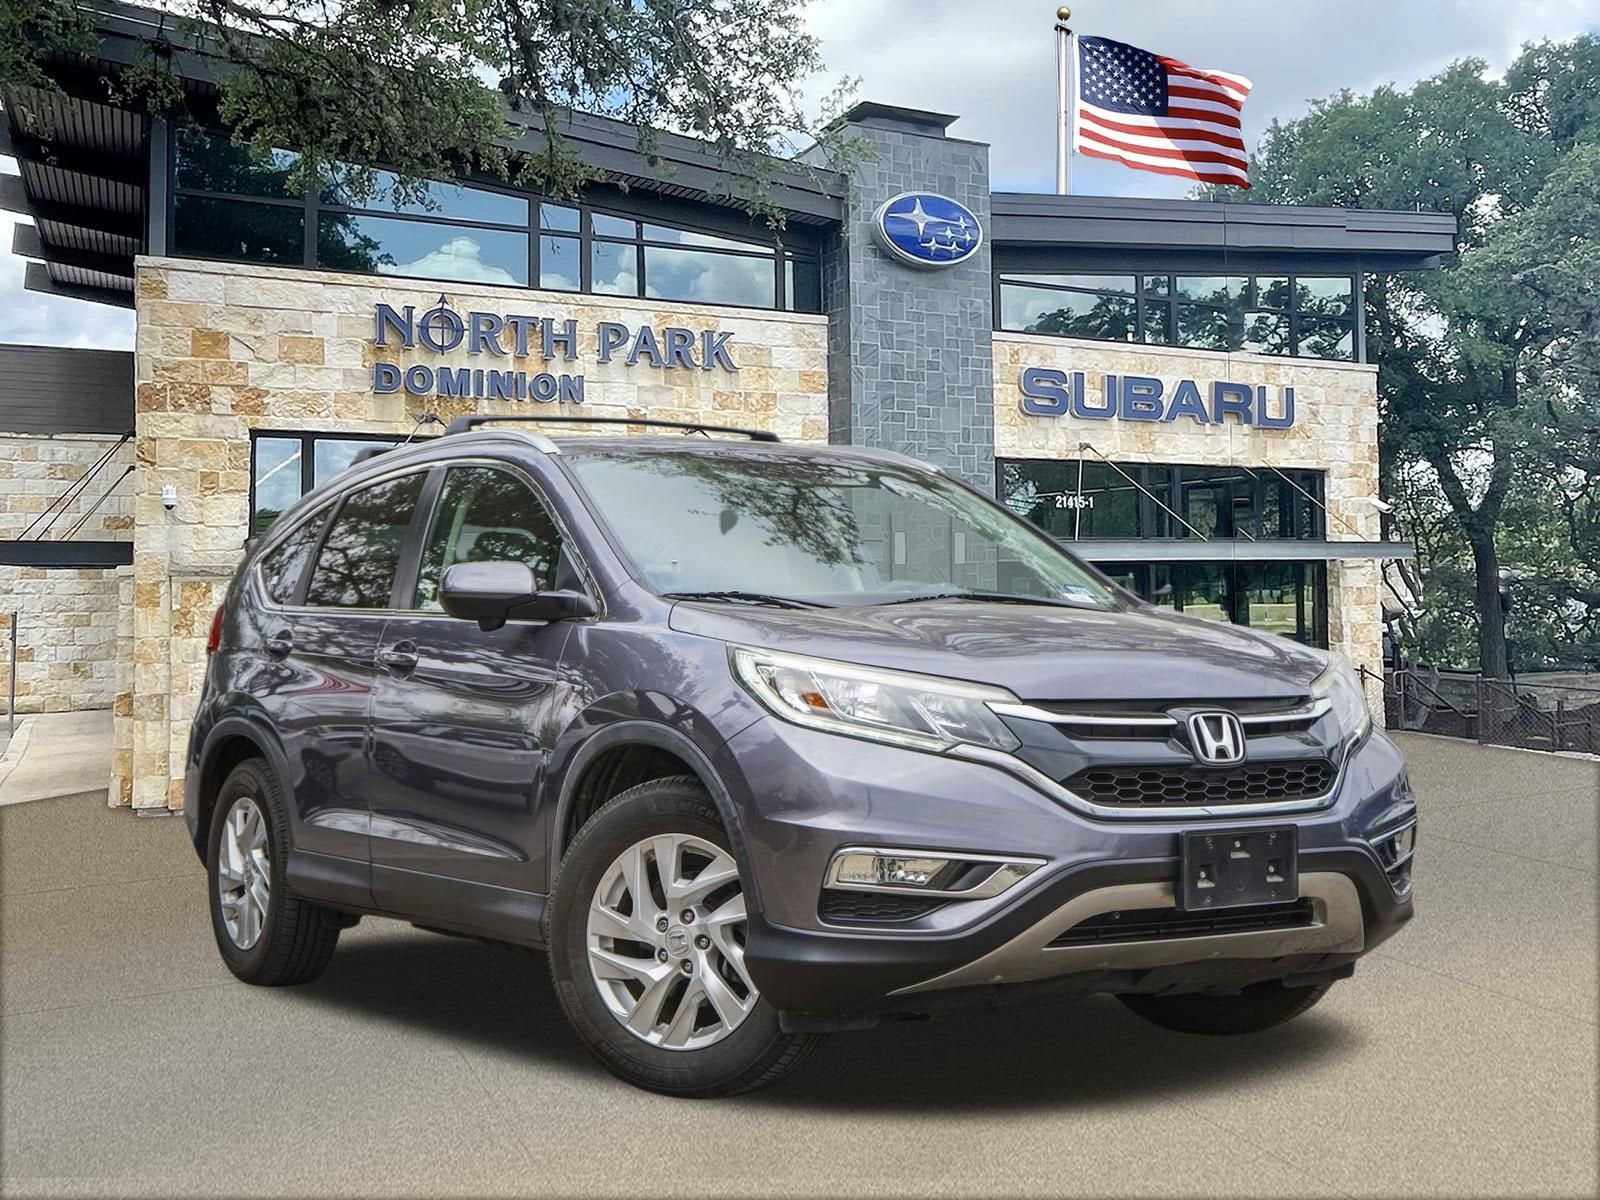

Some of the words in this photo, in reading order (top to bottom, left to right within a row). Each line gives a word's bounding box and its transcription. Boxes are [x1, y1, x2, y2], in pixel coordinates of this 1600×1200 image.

[374, 300, 579, 361] NORTH
[597, 320, 741, 373] PARK
[372, 362, 586, 404] DOMINION
[1019, 367, 1295, 430] SUBARU
[1055, 495, 1094, 509] 21415-1
